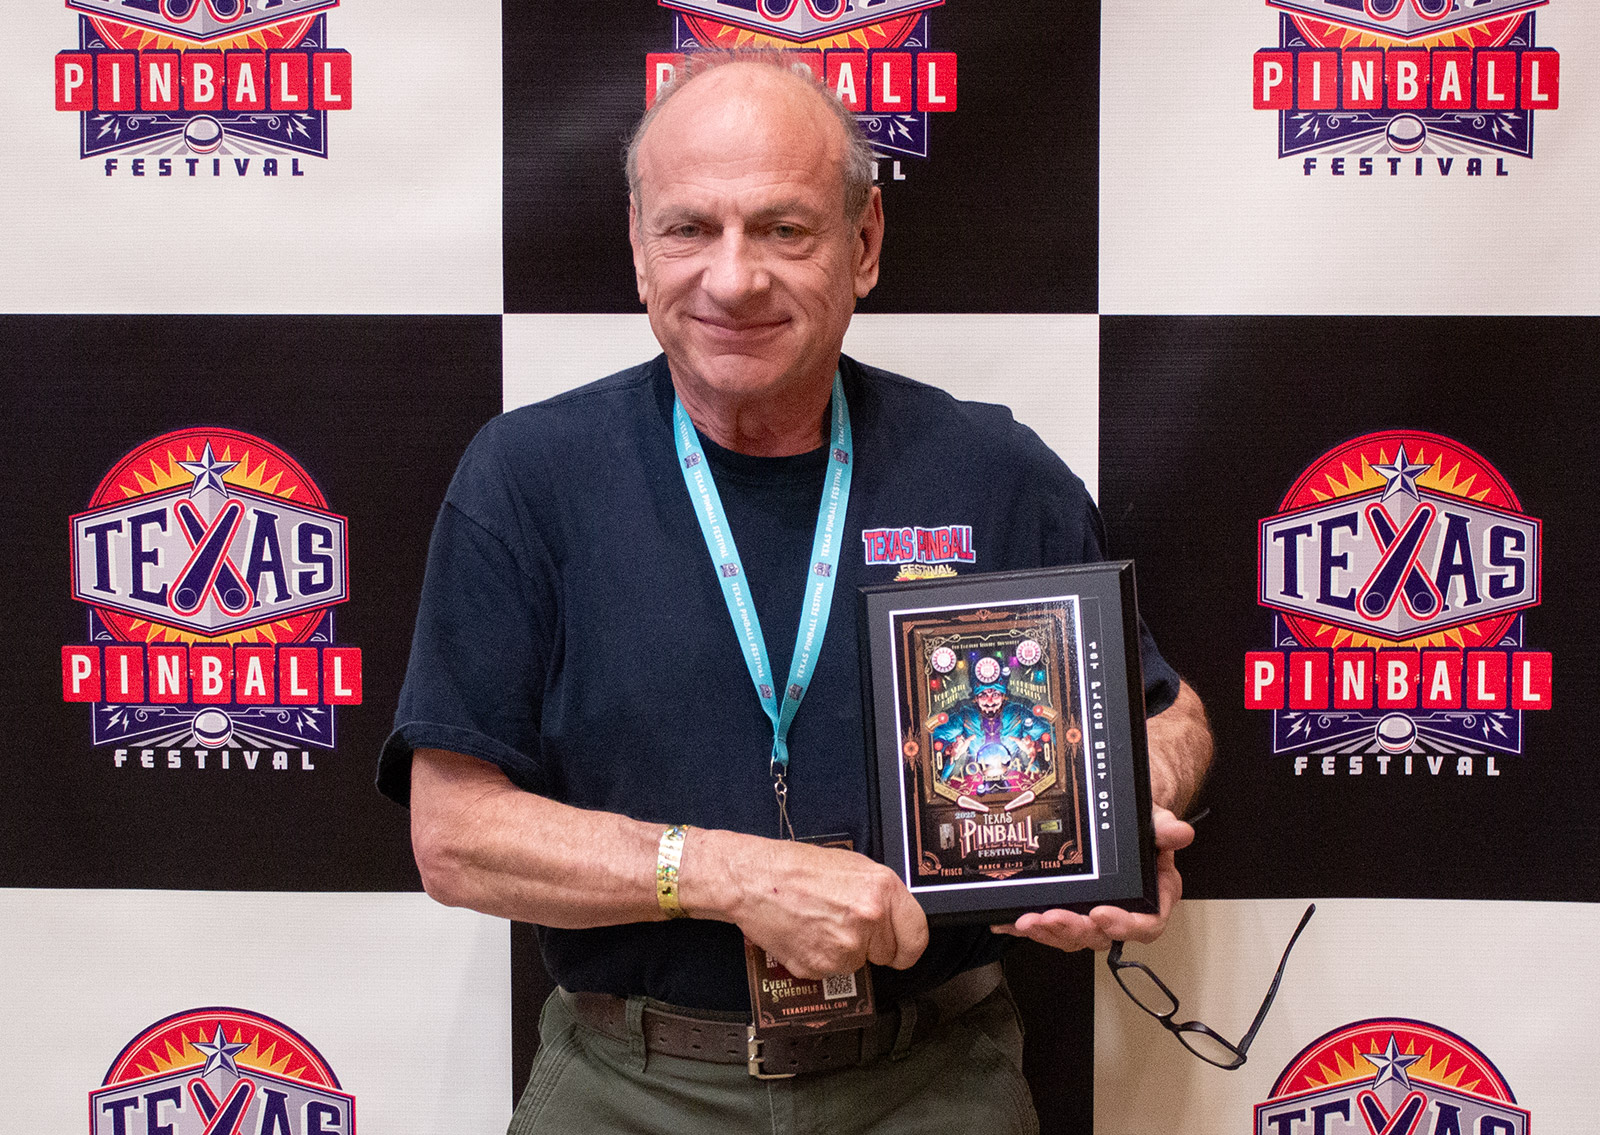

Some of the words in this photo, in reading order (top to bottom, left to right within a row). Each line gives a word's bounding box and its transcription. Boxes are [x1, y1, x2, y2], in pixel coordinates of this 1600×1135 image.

[64, 62, 342, 103] PINBALL
[1262, 61, 1549, 102] PINBALL
[104, 158, 305, 177] FESTIVAL
[1303, 157, 1509, 177] FESTIVAL
[831, 468, 843, 500] FESTIVAL
[693, 470, 707, 494] TEXAS
[702, 493, 717, 525] PINBALL
[712, 525, 729, 559] FESTIVAL
[825, 501, 838, 532] PINBALL
[84, 499, 334, 617] TEXAS
[821, 531, 832, 558] TEXAS
[863, 528, 915, 565] TEXAS
[914, 525, 976, 564] PINBALL
[900, 563, 956, 577] FESTIVAL
[1273, 502, 1526, 621] TEXAS
[731, 582, 745, 607] TEXAS
[739, 608, 755, 641] PINBALL
[750, 642, 765, 679] FESTIVAL
[797, 653, 809, 679] TEXAS
[803, 618, 818, 651] PINBALL
[811, 582, 825, 617] FESTIVAL
[71, 654, 352, 696] PINBALL
[1254, 660, 1541, 701] PINBALL
[113, 748, 315, 770] FESTIVAL
[1294, 755, 1500, 776] FESTIVAL
[954, 811, 976, 820] 2025
[982, 811, 1013, 825] TEXAS
[961, 815, 1040, 855] PINBALL
[978, 847, 1022, 858] FESTIVAL
[1040, 860, 1061, 869] TEXAS
[940, 867, 963, 876] FRISCO
[761, 979, 793, 993] EVENT
[771, 984, 819, 1003] SCHEDULE
